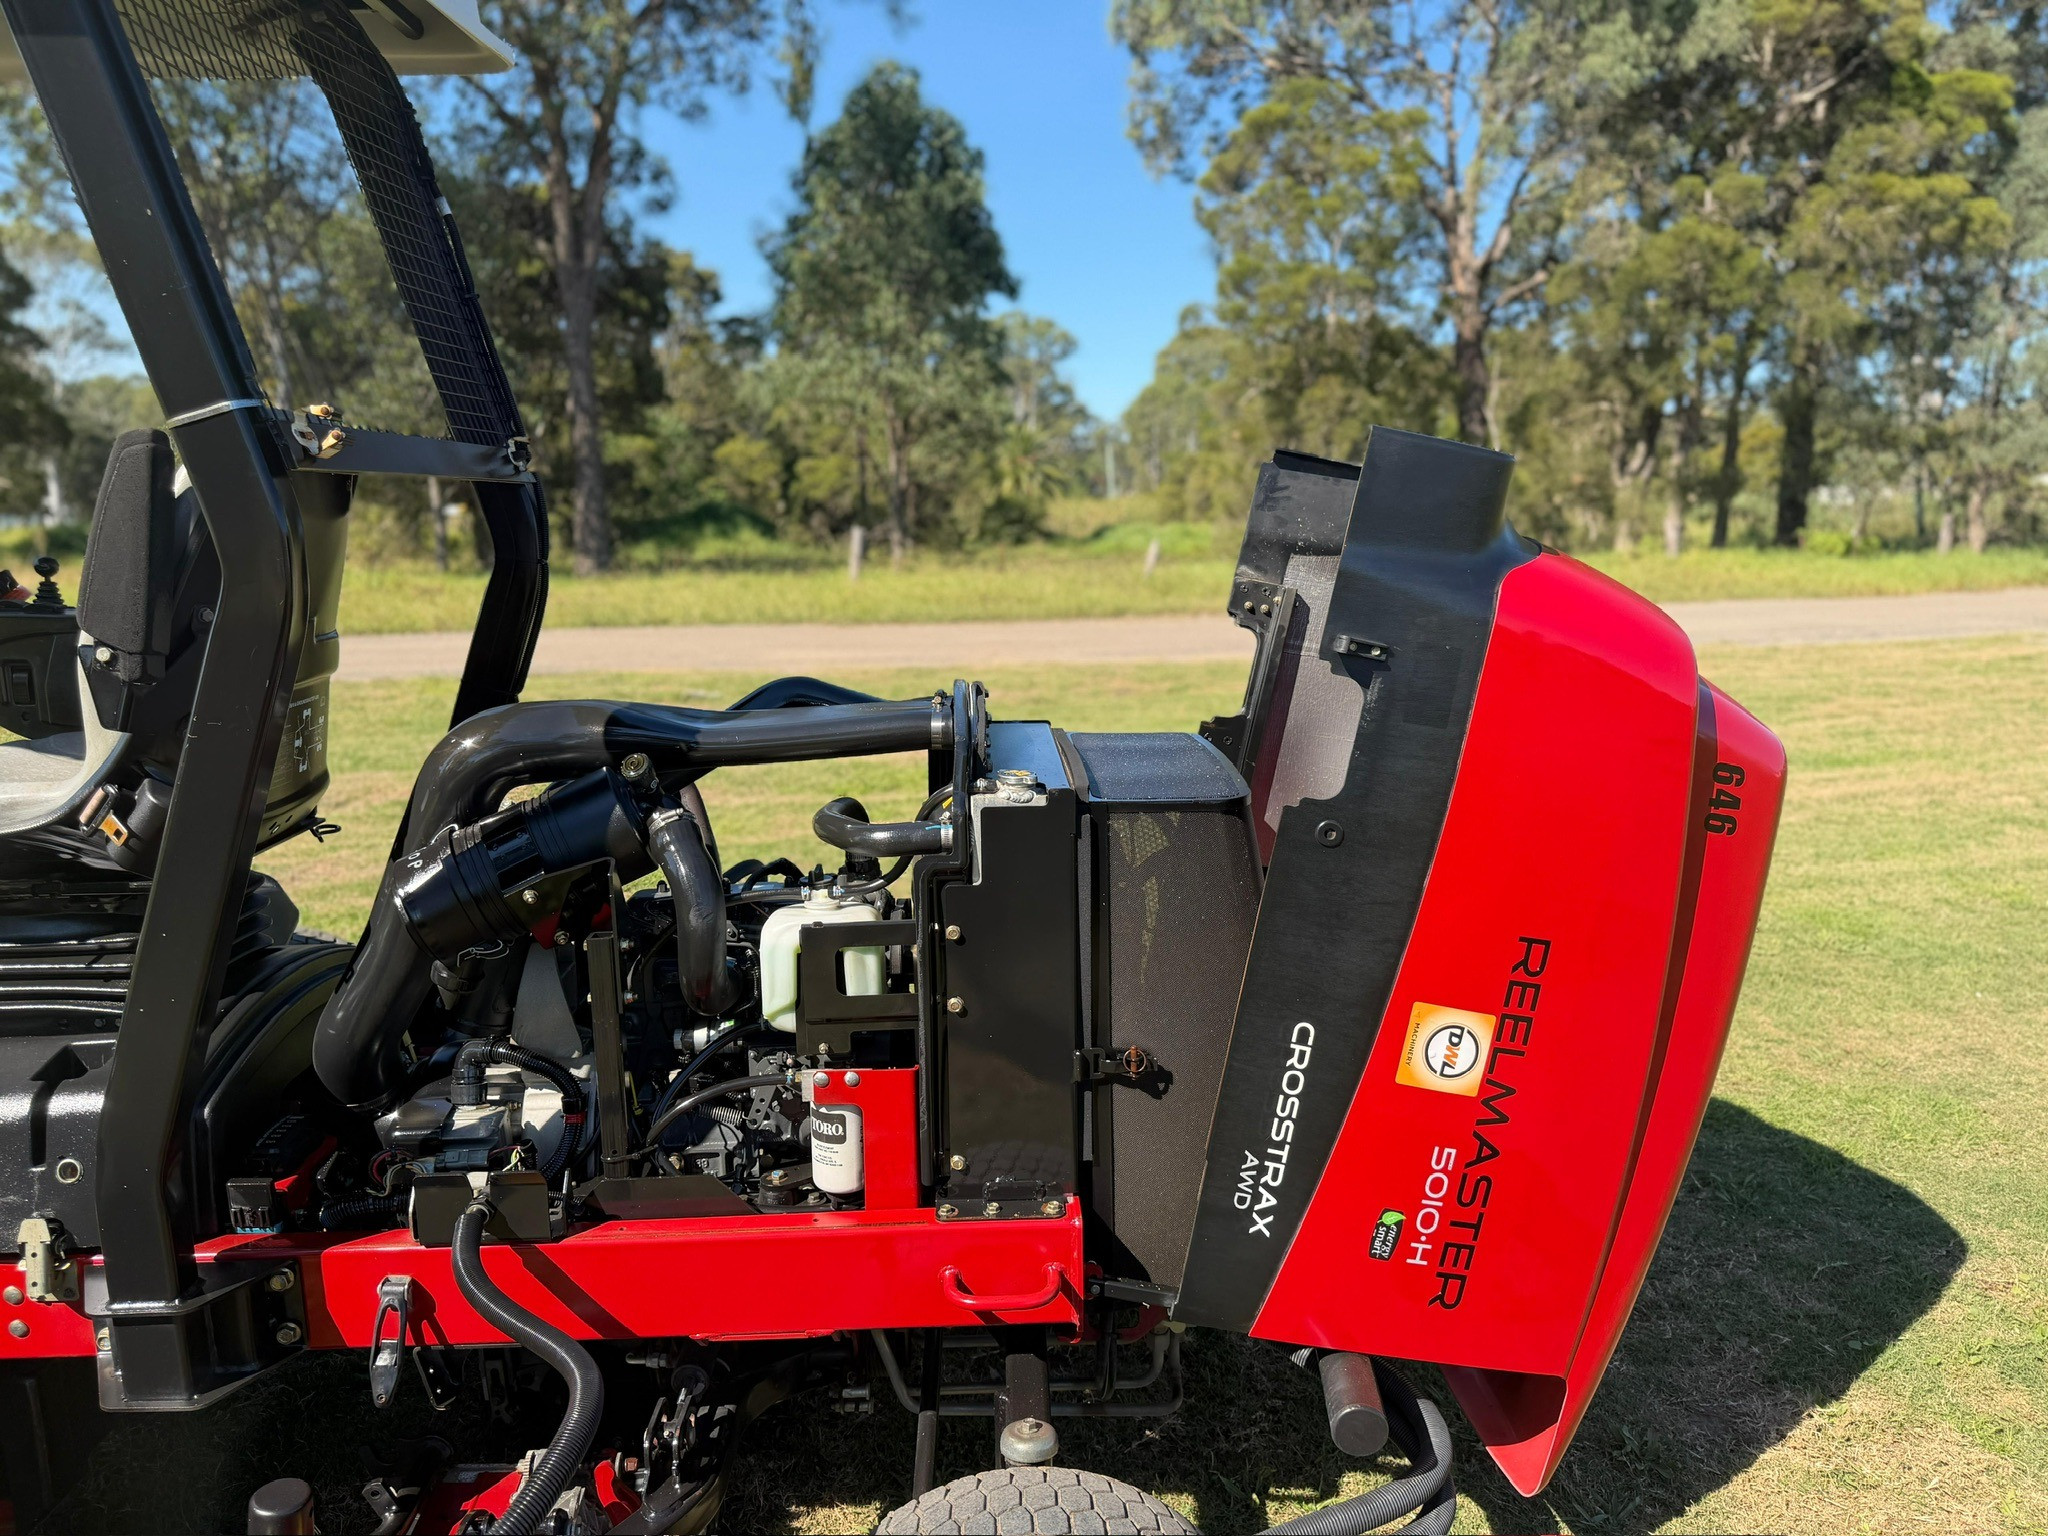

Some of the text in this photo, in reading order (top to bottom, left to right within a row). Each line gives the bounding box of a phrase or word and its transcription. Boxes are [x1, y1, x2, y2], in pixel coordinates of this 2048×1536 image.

[1703, 762, 1745, 836] 646
[1405, 1022, 1421, 1067] MACHINERY
[811, 1116, 843, 1136] TORO
[1248, 1021, 1315, 1238] CROSSTRAX
[1428, 936, 1552, 1310] REELMASTER
[1234, 1149, 1260, 1210] AWD
[1371, 1225, 1387, 1255] smart
[1380, 1223, 1397, 1259] energy
